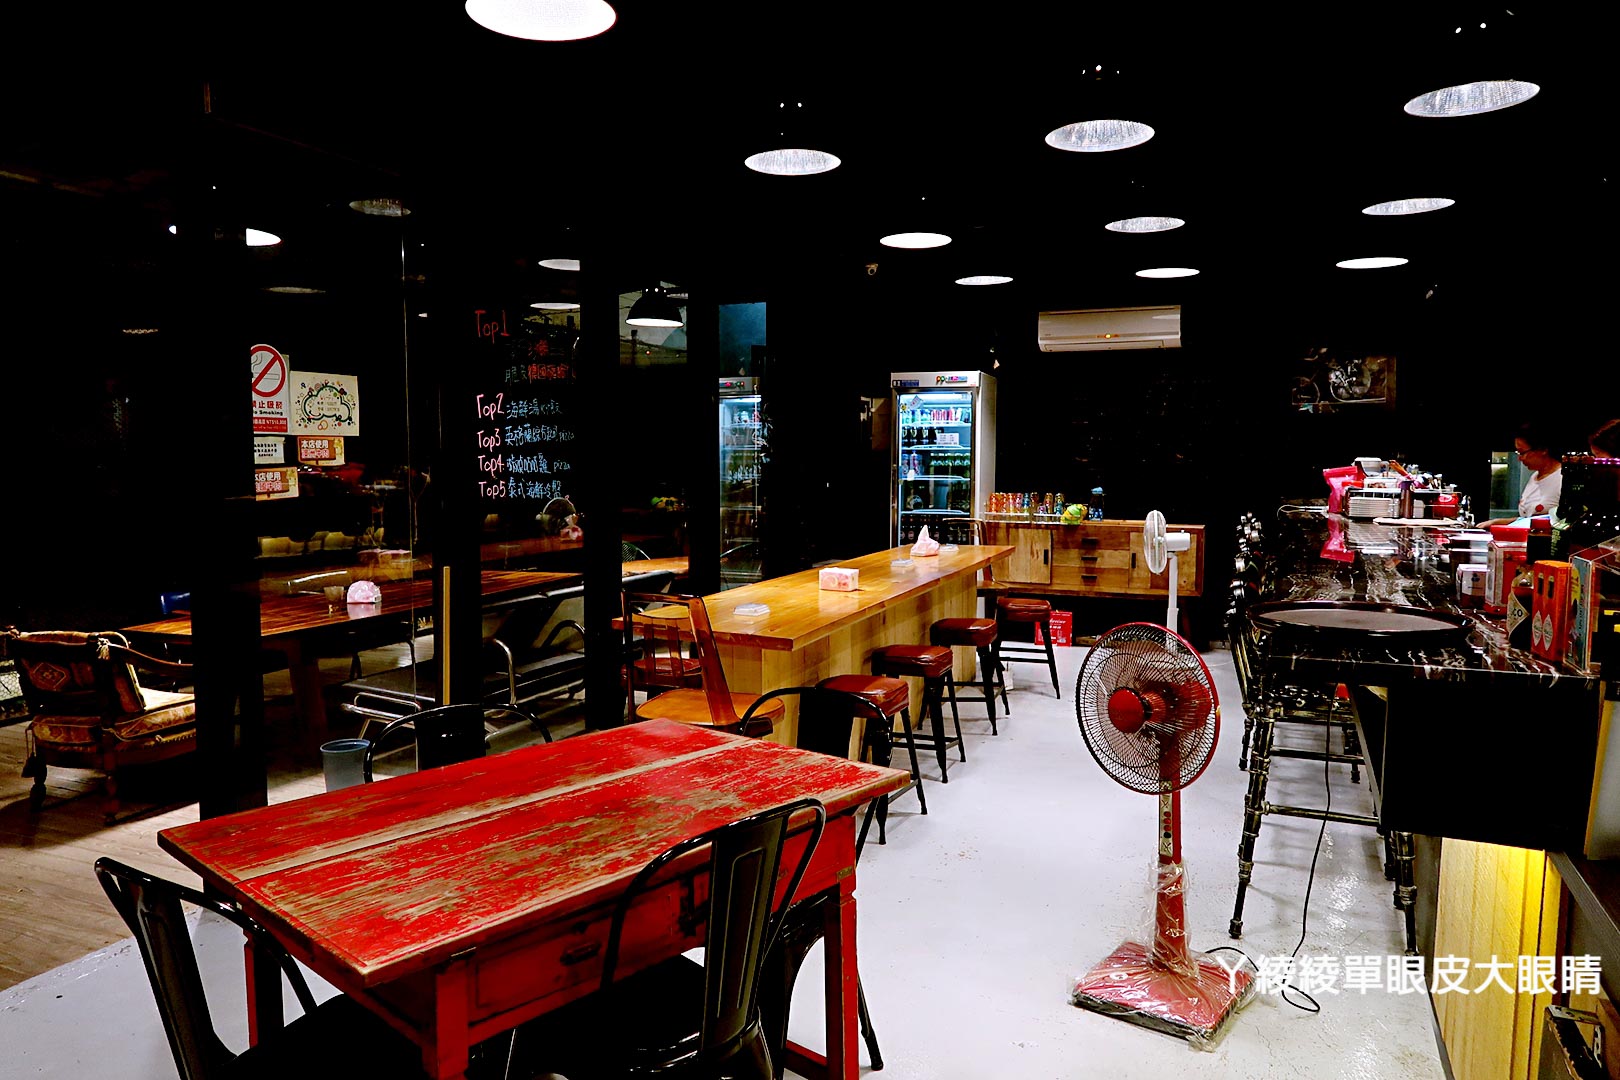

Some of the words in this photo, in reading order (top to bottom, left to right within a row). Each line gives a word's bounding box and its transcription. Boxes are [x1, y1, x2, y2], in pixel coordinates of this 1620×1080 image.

[474, 310, 510, 344] Top1
[476, 393, 505, 420] Top2
[301, 440, 329, 449] 本店使用
[477, 428, 501, 452] Top3
[554, 459, 571, 471] pizza
[478, 481, 505, 499] Top5
